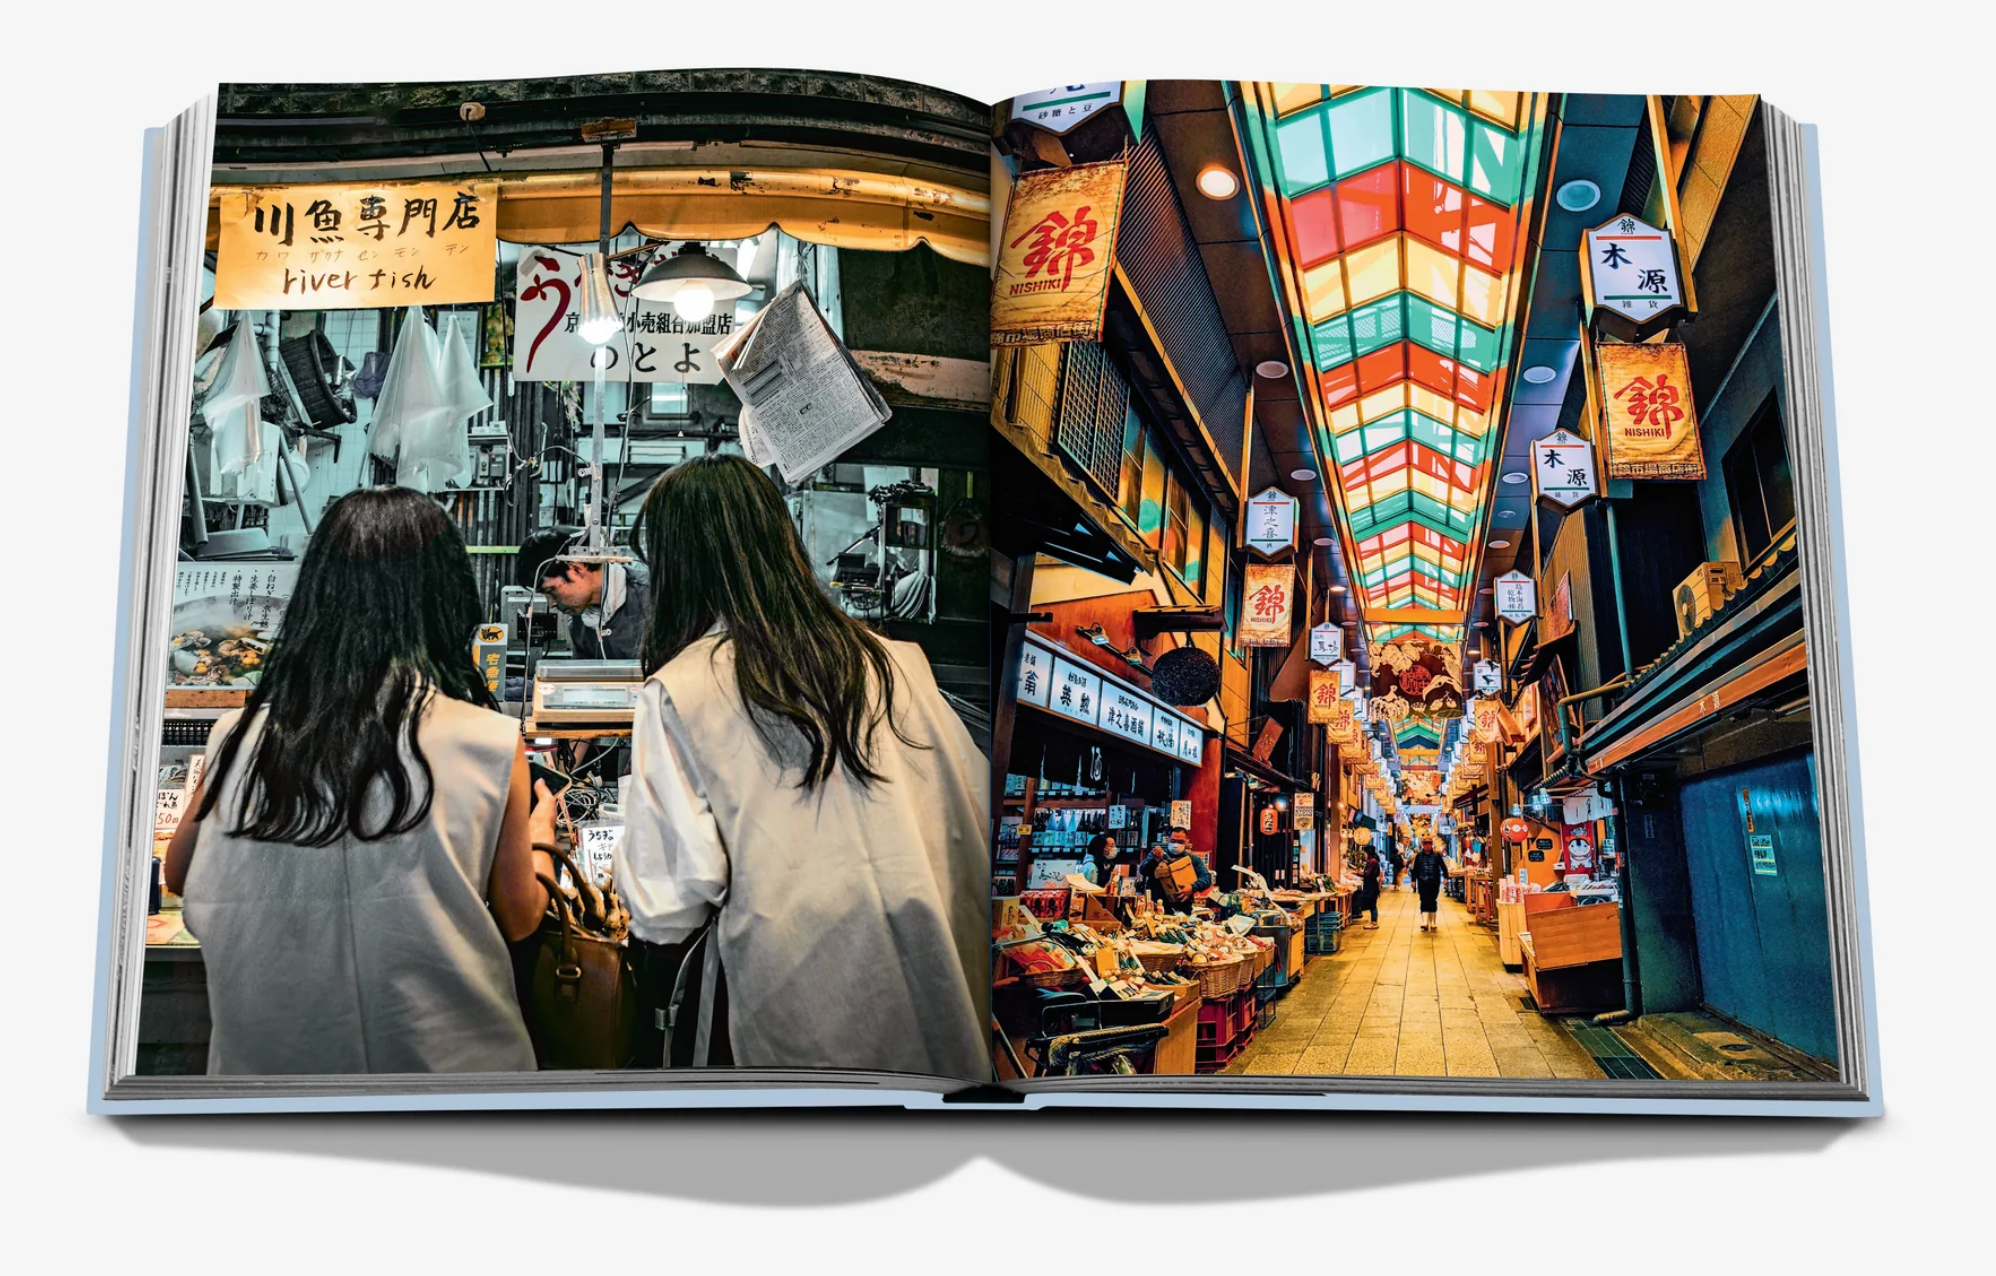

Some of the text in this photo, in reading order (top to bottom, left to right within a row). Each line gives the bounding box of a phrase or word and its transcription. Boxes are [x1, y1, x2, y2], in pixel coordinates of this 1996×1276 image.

[1037, 103, 1093, 120] 砂糖と豆
[254, 190, 480, 247] 川魚専門店
[1617, 218, 1636, 235] 錦
[1010, 205, 1098, 293] 錦
[283, 266, 358, 295] river
[1600, 243, 1668, 294] 木源
[1009, 278, 1062, 296] NISHIKI
[1613, 373, 1685, 440] 錦
[1624, 426, 1665, 438] NISHIKI
[1543, 449, 1587, 487] 木源
[1250, 584, 1285, 624] 錦
[1313, 683, 1337, 709] 錦
